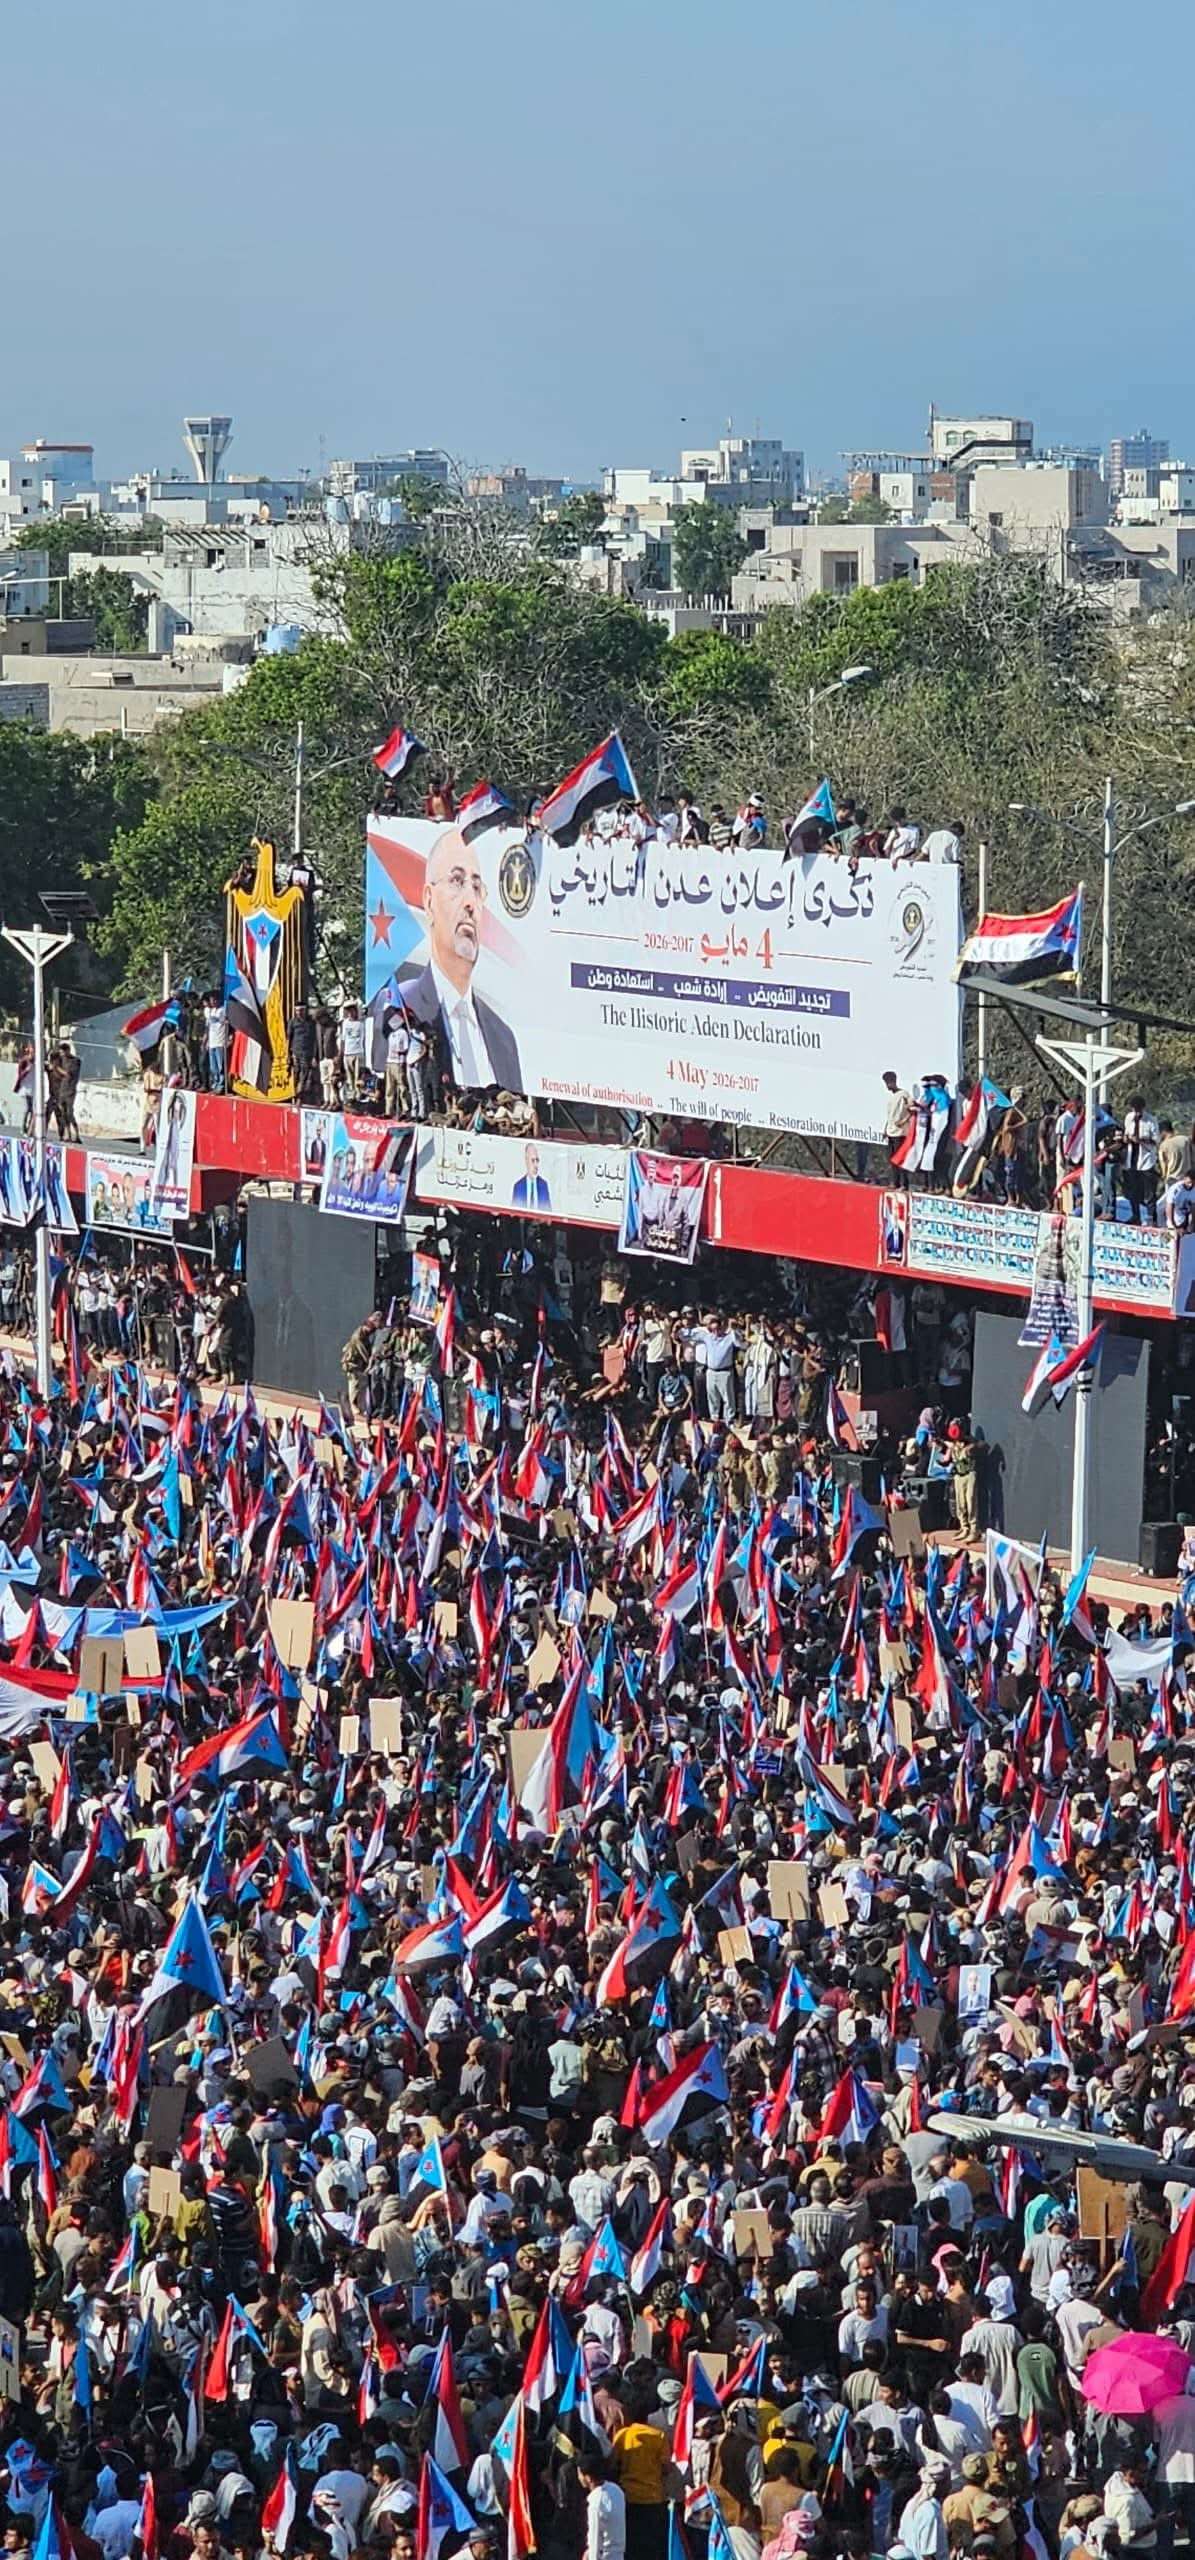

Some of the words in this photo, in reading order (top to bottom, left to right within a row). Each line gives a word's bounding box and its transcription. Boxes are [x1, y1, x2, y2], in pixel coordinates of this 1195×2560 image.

[548, 853, 646, 917] التاريخي
[654, 869, 713, 908] عدن
[720, 868, 796, 930] إعلان
[643, 932, 695, 954] 2026-2017
[700, 922, 749, 965] مايو
[755, 927, 774, 969] 4
[587, 968, 613, 990] وطن
[613, 972, 654, 991] استعادة
[673, 979, 702, 997] شعب
[703, 980, 728, 1004] إرادة
[748, 984, 796, 1008] التفويض
[798, 992, 831, 1013] تجديد
[600, 1003, 627, 1026] The
[631, 1007, 687, 1034] Historic
[692, 1014, 730, 1039] Aden
[734, 1019, 821, 1049] Declaration
[666, 1059, 674, 1080] 4
[677, 1060, 708, 1089] May
[712, 1072, 760, 1092] 2026-2017
[541, 1077, 580, 1095] Renewal
[581, 1083, 591, 1098] of
[592, 1088, 653, 1108] authorisation
[670, 1097, 687, 1113] The
[689, 1100, 707, 1115] will
[708, 1102, 719, 1116] of
[721, 1107, 752, 1122] people
[769, 1111, 826, 1133] Restoration
[827, 1120, 838, 1134] of
[840, 1123, 888, 1143] Homelan
